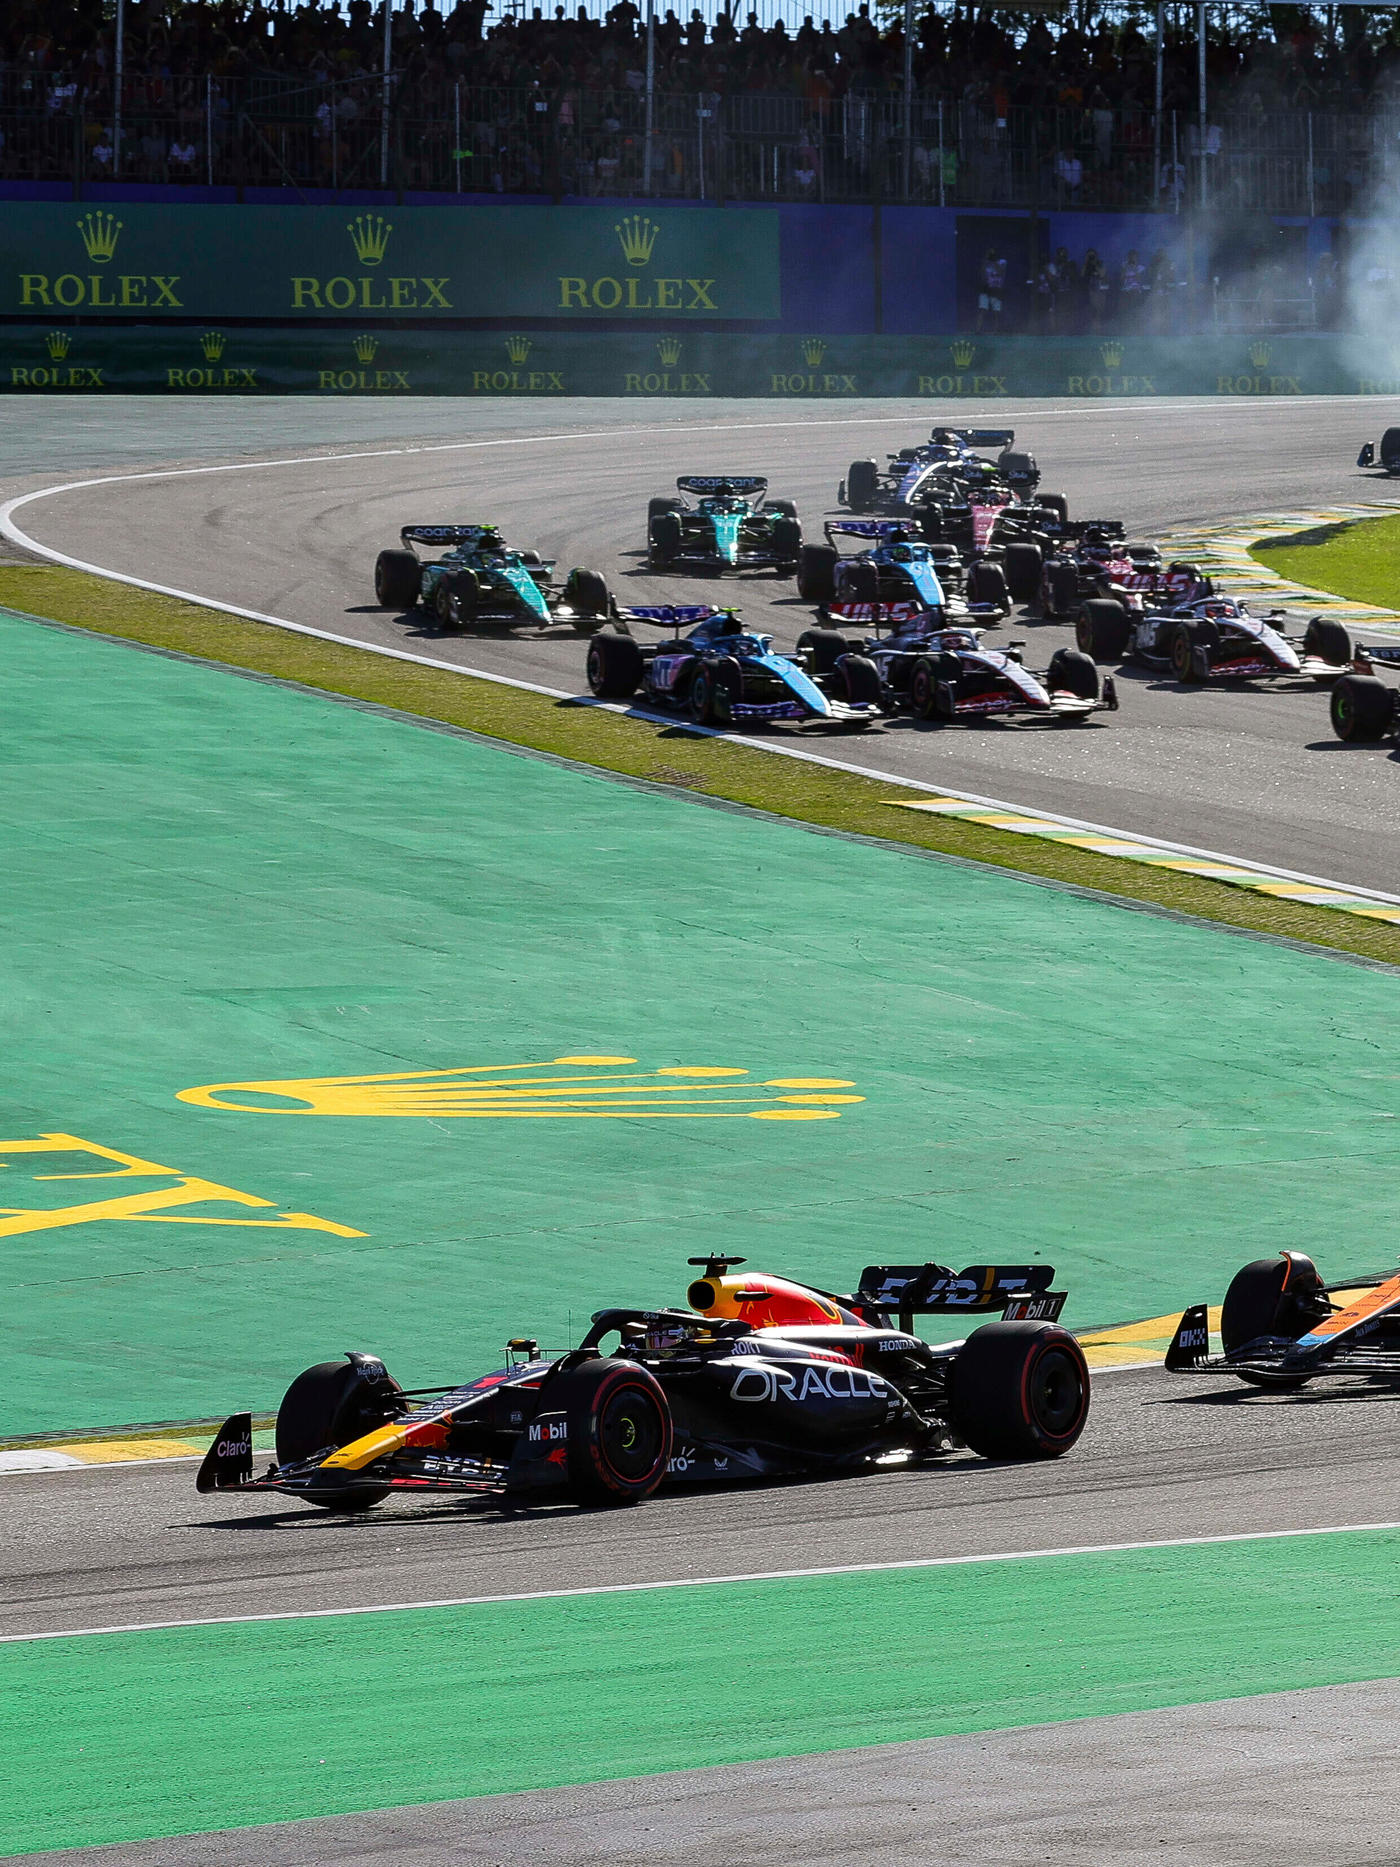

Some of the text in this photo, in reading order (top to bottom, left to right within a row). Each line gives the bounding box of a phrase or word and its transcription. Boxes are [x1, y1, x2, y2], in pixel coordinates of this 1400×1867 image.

[19, 274, 184, 307] ROLEX
[290, 276, 453, 309] ROLEX
[558, 276, 718, 309] ROLEX
[11, 367, 104, 386] ROLEX
[167, 368, 257, 387] ROLEX
[319, 371, 411, 390] ROLEX
[472, 371, 565, 391] ROLEX
[624, 373, 712, 392] ROLEX
[771, 374, 858, 393] ROLEX
[919, 376, 1008, 394] ROLEX
[1069, 376, 1157, 394] ROLEX
[1216, 376, 1303, 395] ROLEX
[1003, 1300, 1046, 1321] Mobil
[879, 1340, 917, 1352] HONDA
[1179, 1328, 1206, 1347] OKX
[730, 1367, 888, 1402] ORACLE
[529, 1421, 568, 1441] Mobil
[217, 1437, 249, 1457] Claro
